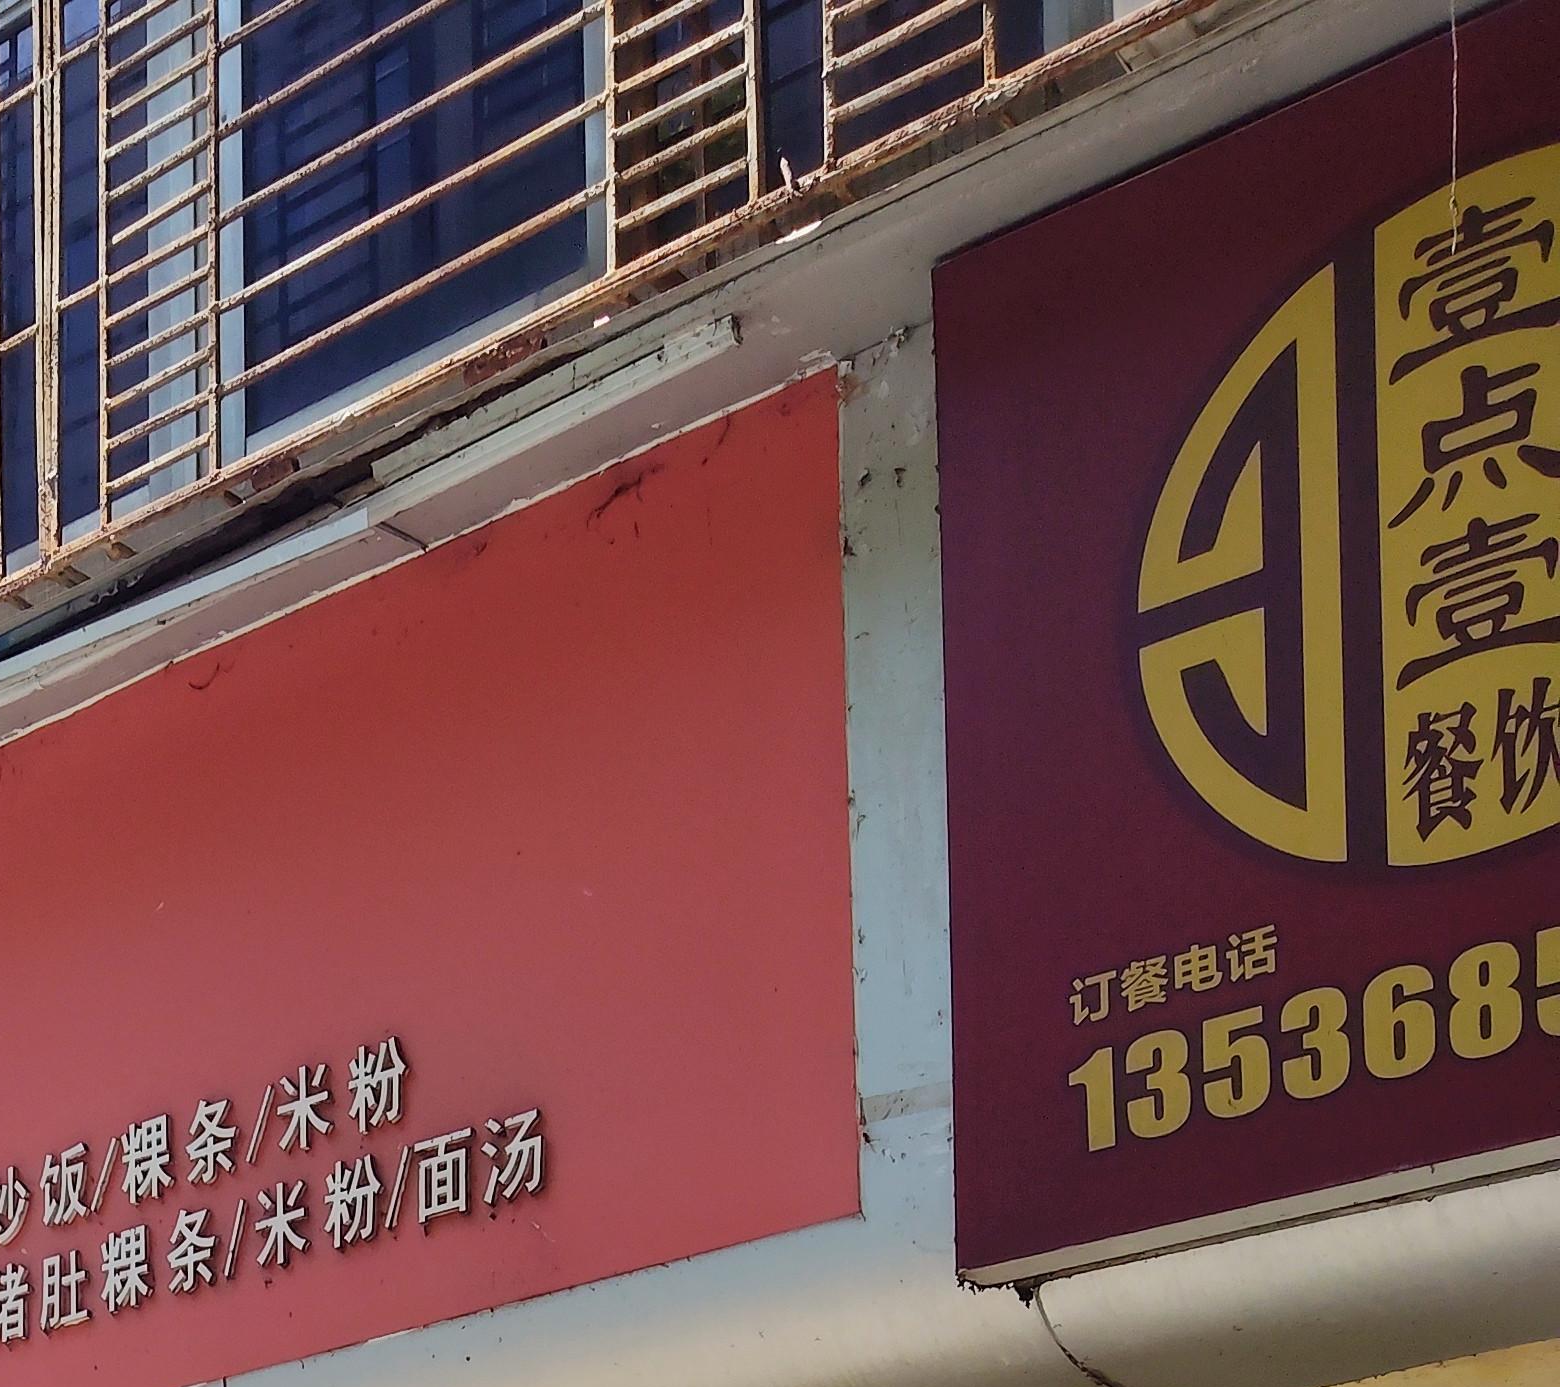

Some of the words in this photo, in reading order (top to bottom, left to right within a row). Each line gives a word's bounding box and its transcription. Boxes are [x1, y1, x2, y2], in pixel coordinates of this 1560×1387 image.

[1388, 198, 1560, 690] 壹点壹
[1402, 677, 1560, 842] 餐饮
[1068, 923, 1278, 1027] 订餐电话
